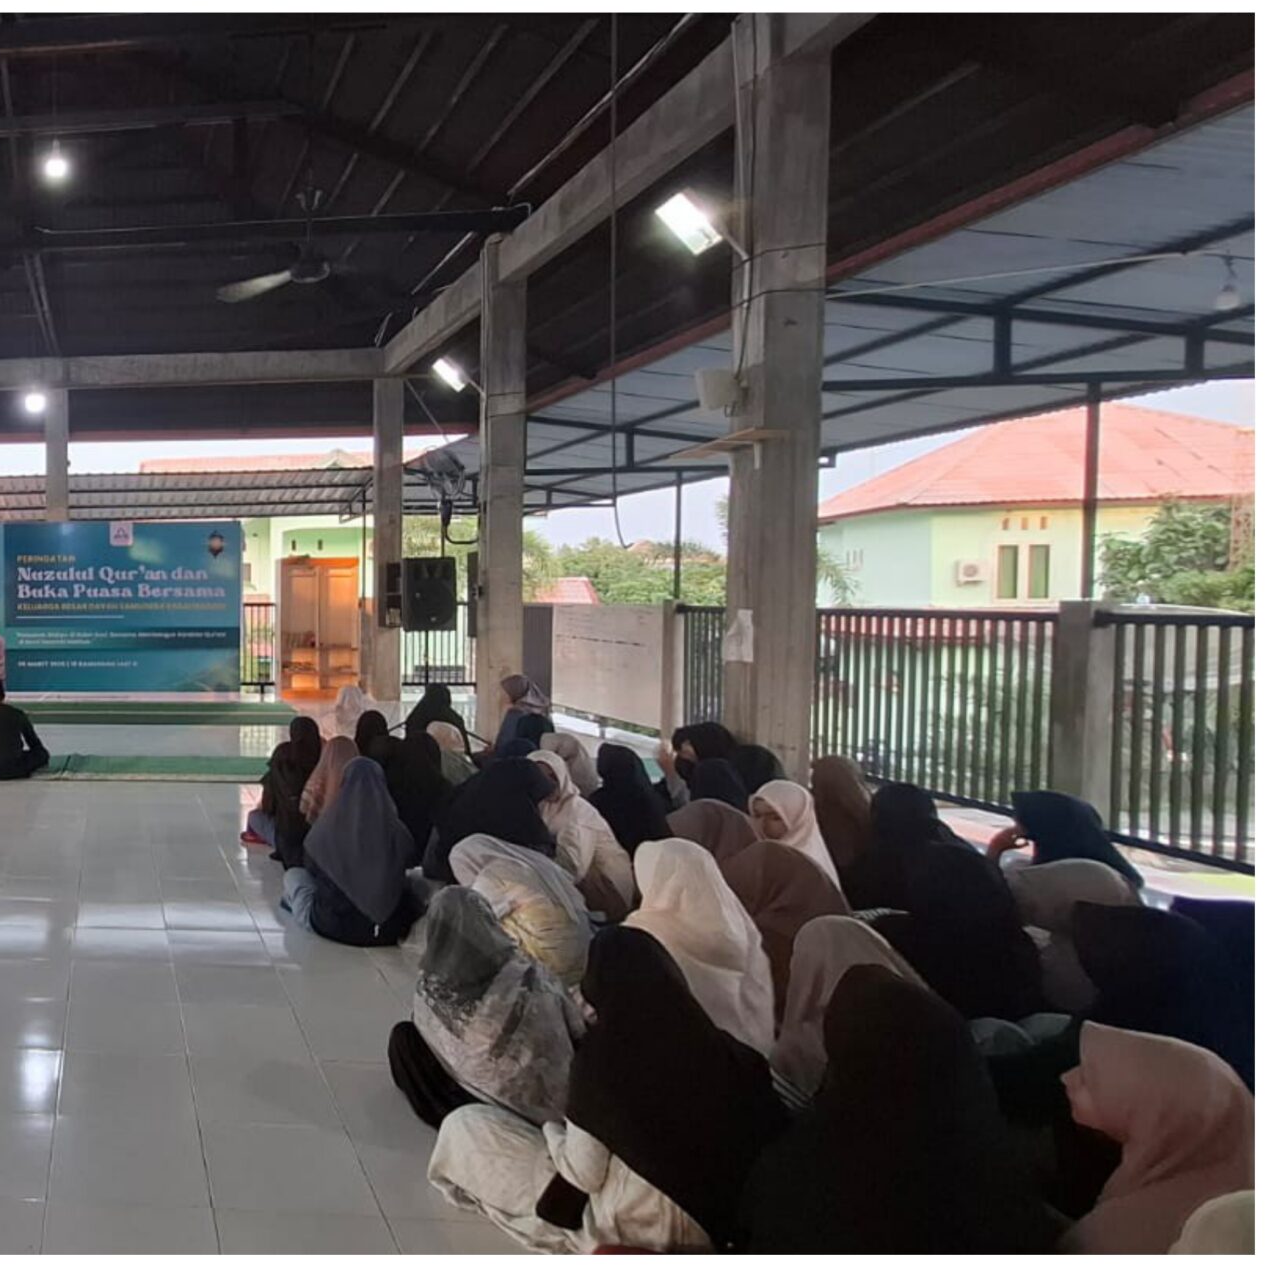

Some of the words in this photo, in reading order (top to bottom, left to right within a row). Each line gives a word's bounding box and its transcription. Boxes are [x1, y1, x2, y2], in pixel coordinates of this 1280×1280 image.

[16, 567, 94, 581] Nuzulul
[171, 566, 208, 581] dan
[17, 583, 69, 599] Buka
[73, 583, 133, 598] Puasa
[137, 583, 226, 598] Bersama
